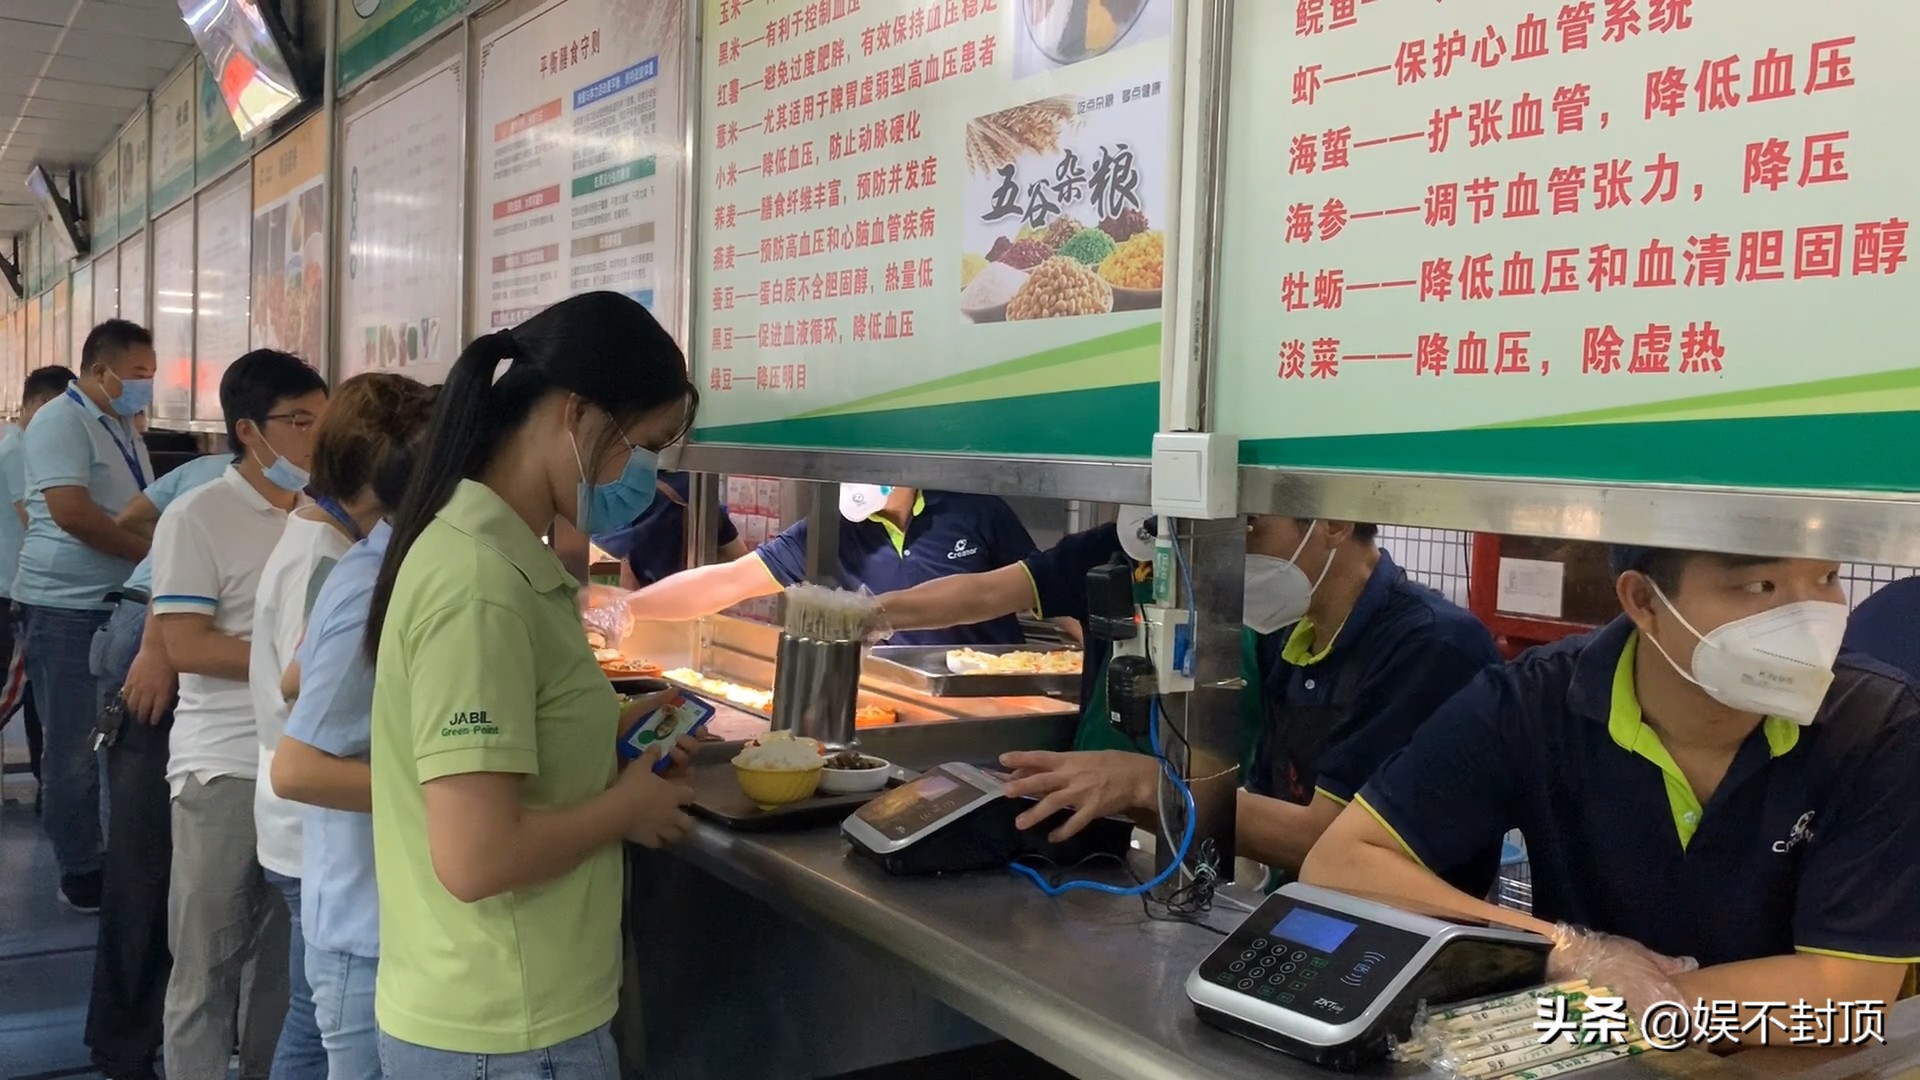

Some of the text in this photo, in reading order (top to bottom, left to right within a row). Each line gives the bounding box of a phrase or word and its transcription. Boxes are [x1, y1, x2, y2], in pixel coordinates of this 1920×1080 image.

[981, 144, 1140, 229] 五谷杂粮
[449, 711, 492, 725] JABIL
